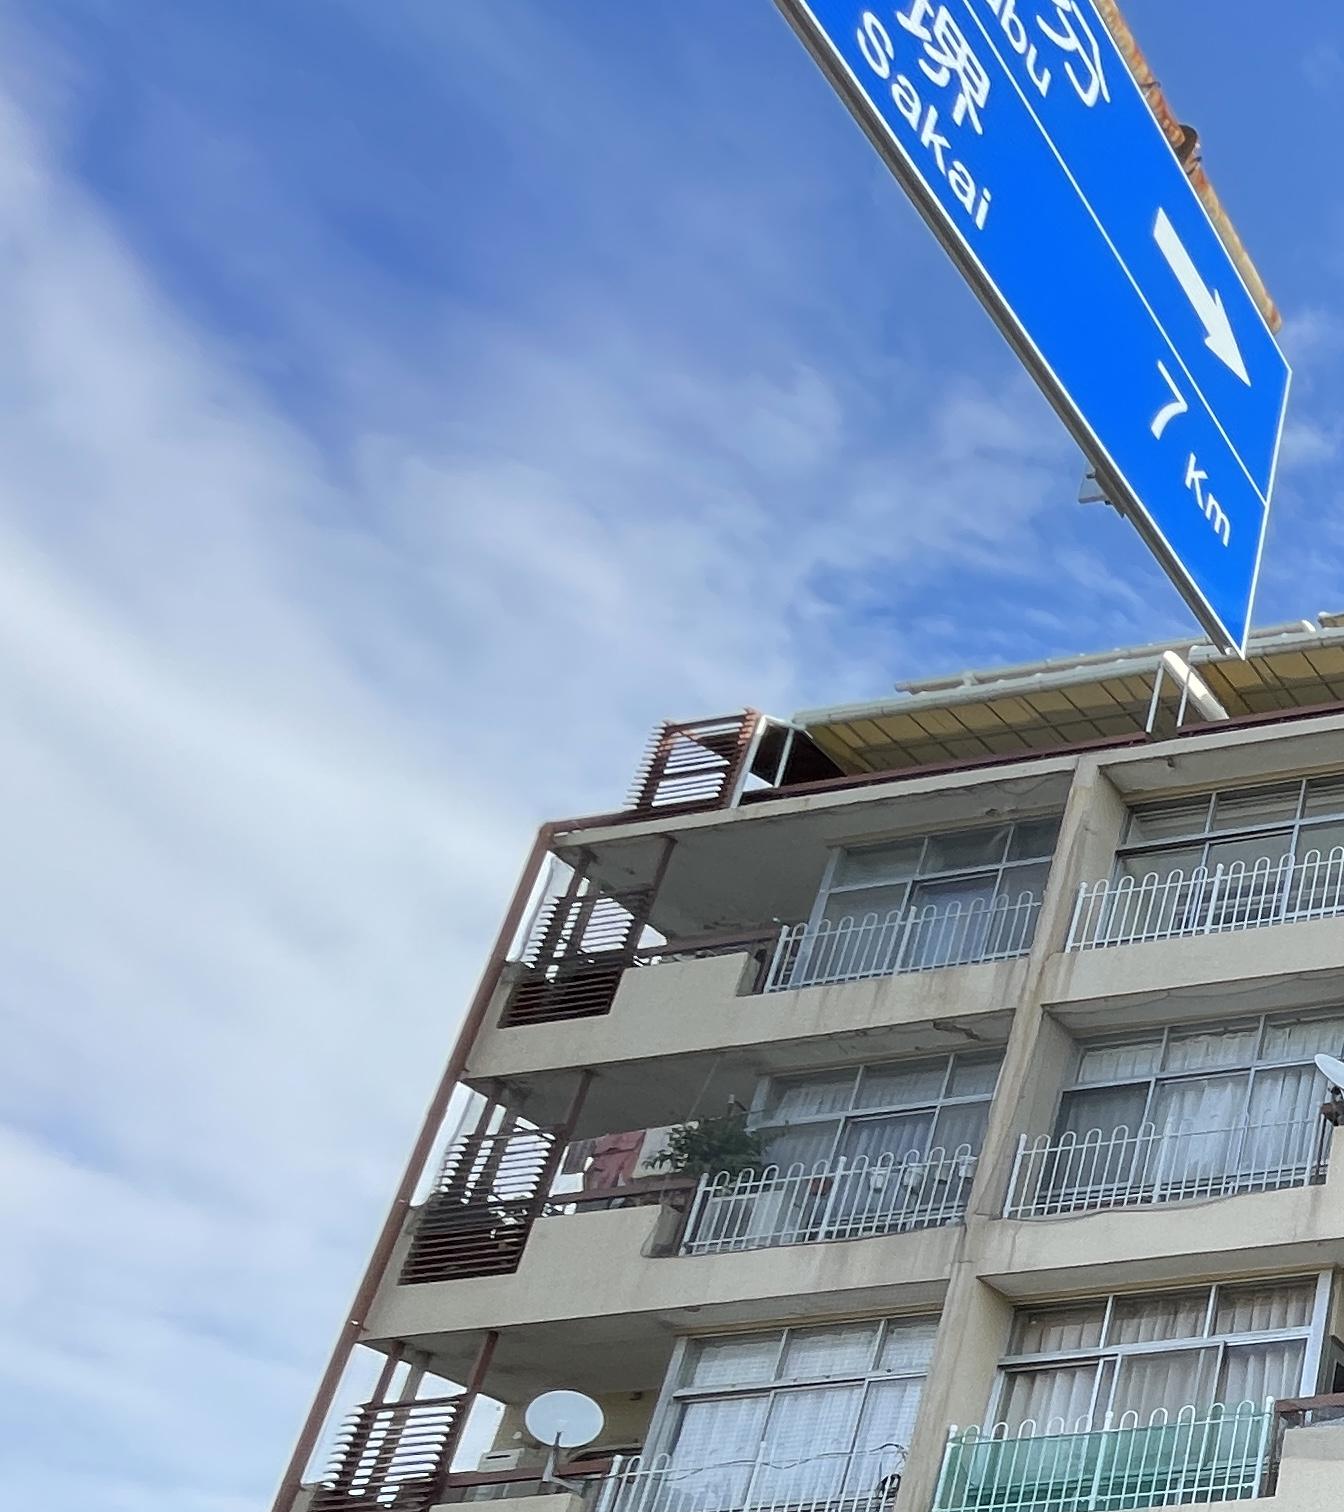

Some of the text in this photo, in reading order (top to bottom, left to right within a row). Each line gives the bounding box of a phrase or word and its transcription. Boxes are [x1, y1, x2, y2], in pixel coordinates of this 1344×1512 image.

[856, 10, 992, 231] Sakai
[895, 0, 991, 136] 堺
[1150, 359, 1189, 441] 7
